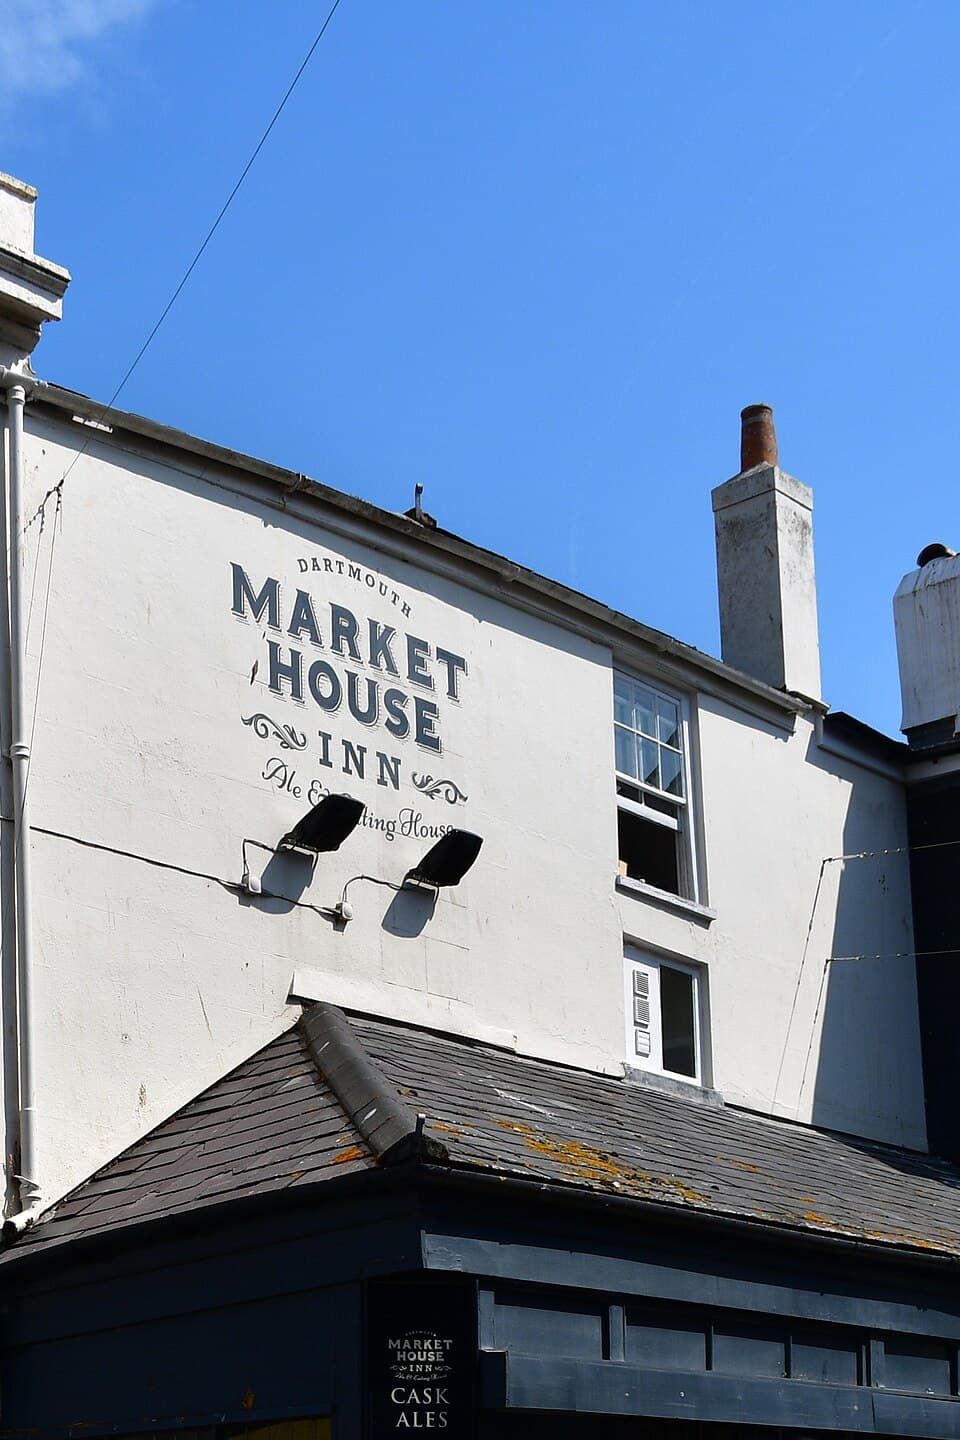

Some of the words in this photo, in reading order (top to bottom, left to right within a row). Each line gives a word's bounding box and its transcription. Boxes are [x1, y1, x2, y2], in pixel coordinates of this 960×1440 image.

[297, 557, 412, 619] DARTMOUTH
[229, 561, 468, 704] MARKET
[265, 638, 443, 756] HOUSE
[318, 730, 402, 791] INN
[261, 757, 302, 799] Ale
[388, 1338, 453, 1350] MARKET
[396, 1351, 445, 1362] HOUSE
[409, 1364, 433, 1372] INN
[390, 1387, 451, 1405] CASK
[396, 1411, 448, 1428] ALES
